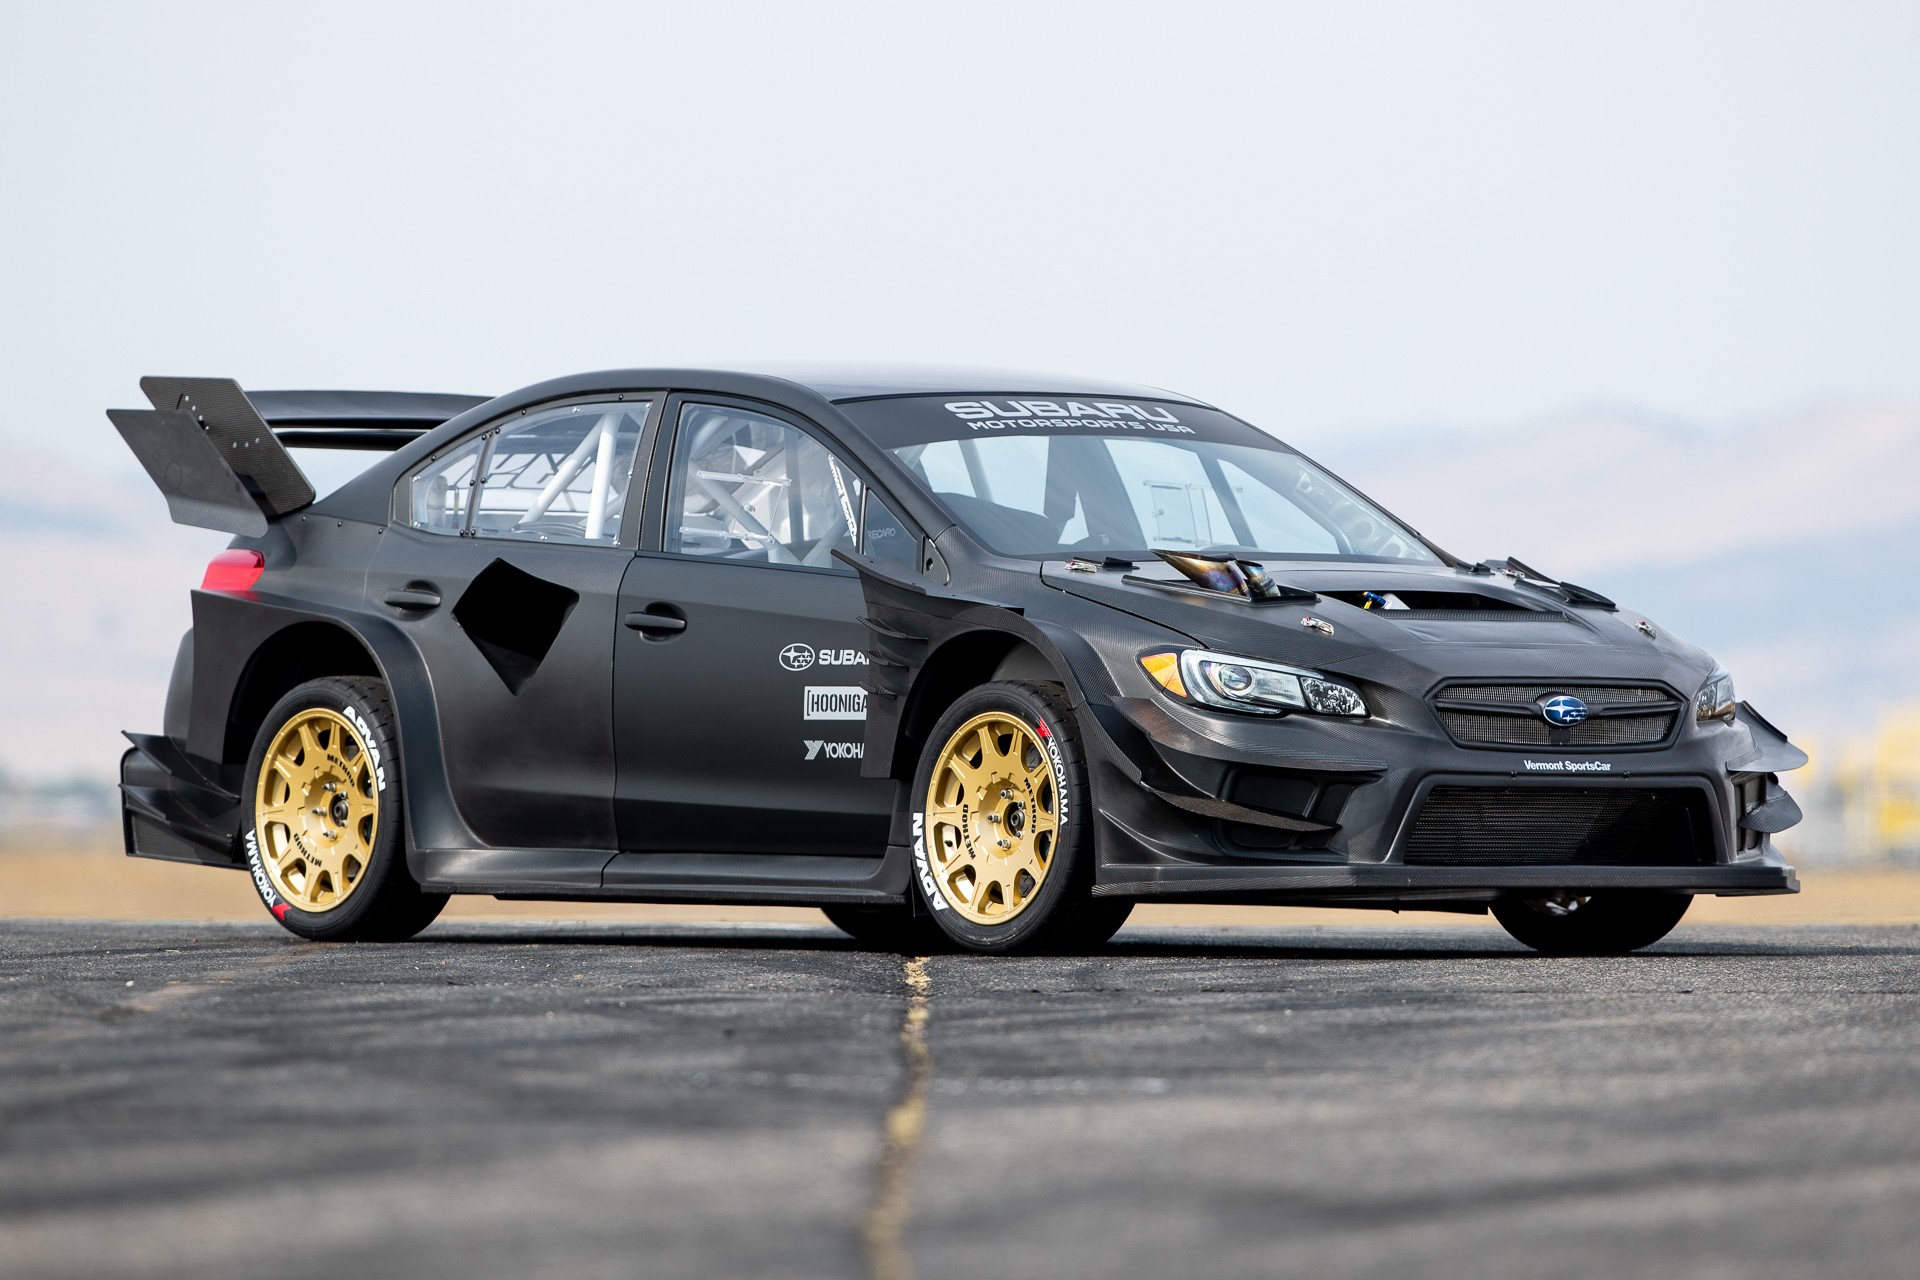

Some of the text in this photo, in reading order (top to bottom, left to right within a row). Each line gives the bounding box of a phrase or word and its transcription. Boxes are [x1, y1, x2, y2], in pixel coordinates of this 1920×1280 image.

[944, 400, 1180, 424] SUBARU
[966, 418, 1196, 435] MOTORSPORTS USA
[326, 753, 355, 788] METHOD
[342, 705, 386, 792] ADVAN
[1523, 760, 1611, 772] Vermont SportsCar
[1023, 776, 1037, 834] METHOD
[1047, 735, 1069, 826] YOKOHAMA
[293, 832, 323, 868] METHOD
[961, 803, 976, 860] METHOD
[245, 828, 277, 908] YOKOHAMA
[912, 812, 949, 912] ADVAN
